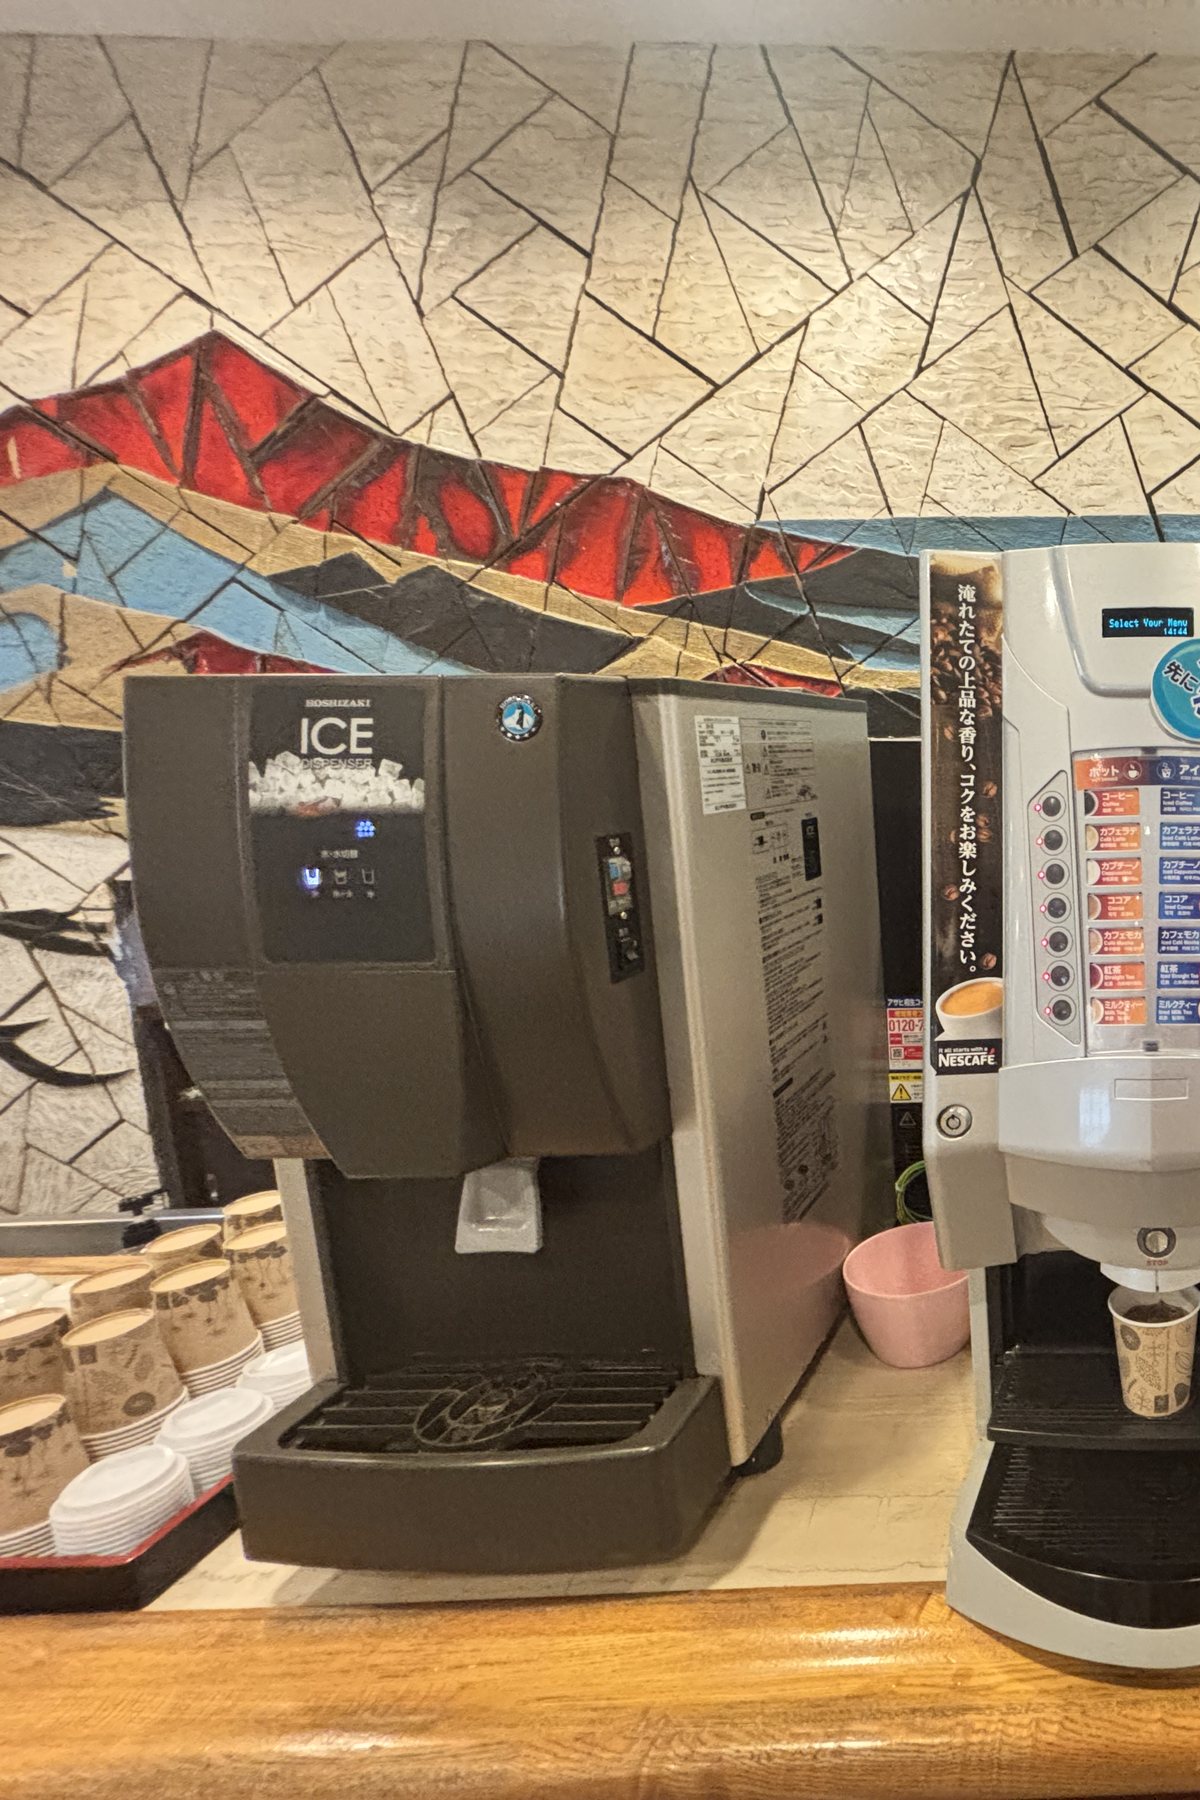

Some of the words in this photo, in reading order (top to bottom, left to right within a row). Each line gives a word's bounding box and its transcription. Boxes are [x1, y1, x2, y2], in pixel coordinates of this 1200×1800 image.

[1109, 618, 1139, 628] Select
[1143, 618, 1163, 627] Your
[1167, 618, 1188, 627] Menu
[1163, 627, 1188, 635] 14:44
[305, 699, 371, 708] HOSHIZAKI
[300, 717, 374, 755] ICE
[302, 758, 374, 770] DISPENSER
[957, 583, 977, 973] 淹れたての上品な香り、コクをお楽しみください。
[1101, 792, 1135, 801] コーヒー
[1162, 791, 1195, 799] コーヒー
[1099, 827, 1137, 836] カフェラテ
[1161, 826, 1200, 835] カフェラテ
[1101, 861, 1140, 870] カプチーノ
[1162, 860, 1200, 869] カプチーノ
[1107, 896, 1131, 905] ココア
[1164, 895, 1188, 903] ココア
[1103, 931, 1142, 940] カフェモカ
[1161, 930, 1200, 939] カフェモカ
[1104, 965, 1122, 974] 紅茶
[1160, 964, 1178, 973] 紅茶
[1158, 1000, 1197, 1009] ミルクティー
